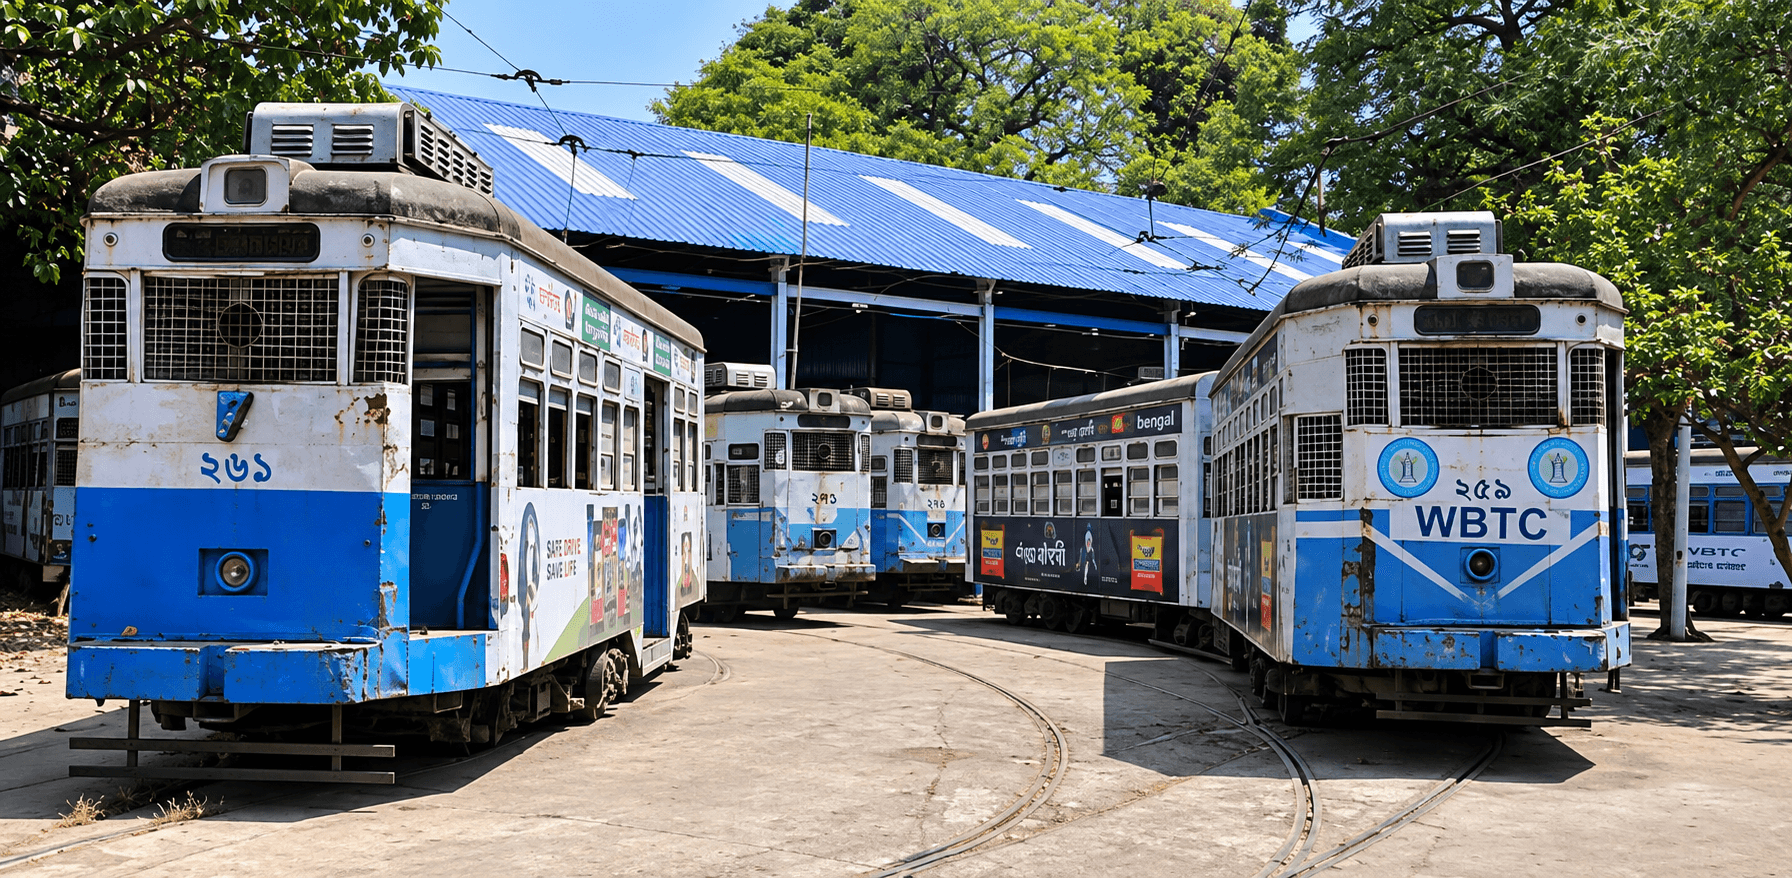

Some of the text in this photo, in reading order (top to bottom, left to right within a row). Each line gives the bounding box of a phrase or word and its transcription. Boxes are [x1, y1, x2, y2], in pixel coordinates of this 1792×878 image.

[1137, 410, 1174, 431] bengal
[200, 452, 272, 485] ২৬১
[1455, 478, 1511, 502] ২৫৯
[1415, 505, 1548, 541] WBTC
[547, 538, 581, 559] SAFE DRIVE
[547, 559, 577, 580] SAVE LIFE
